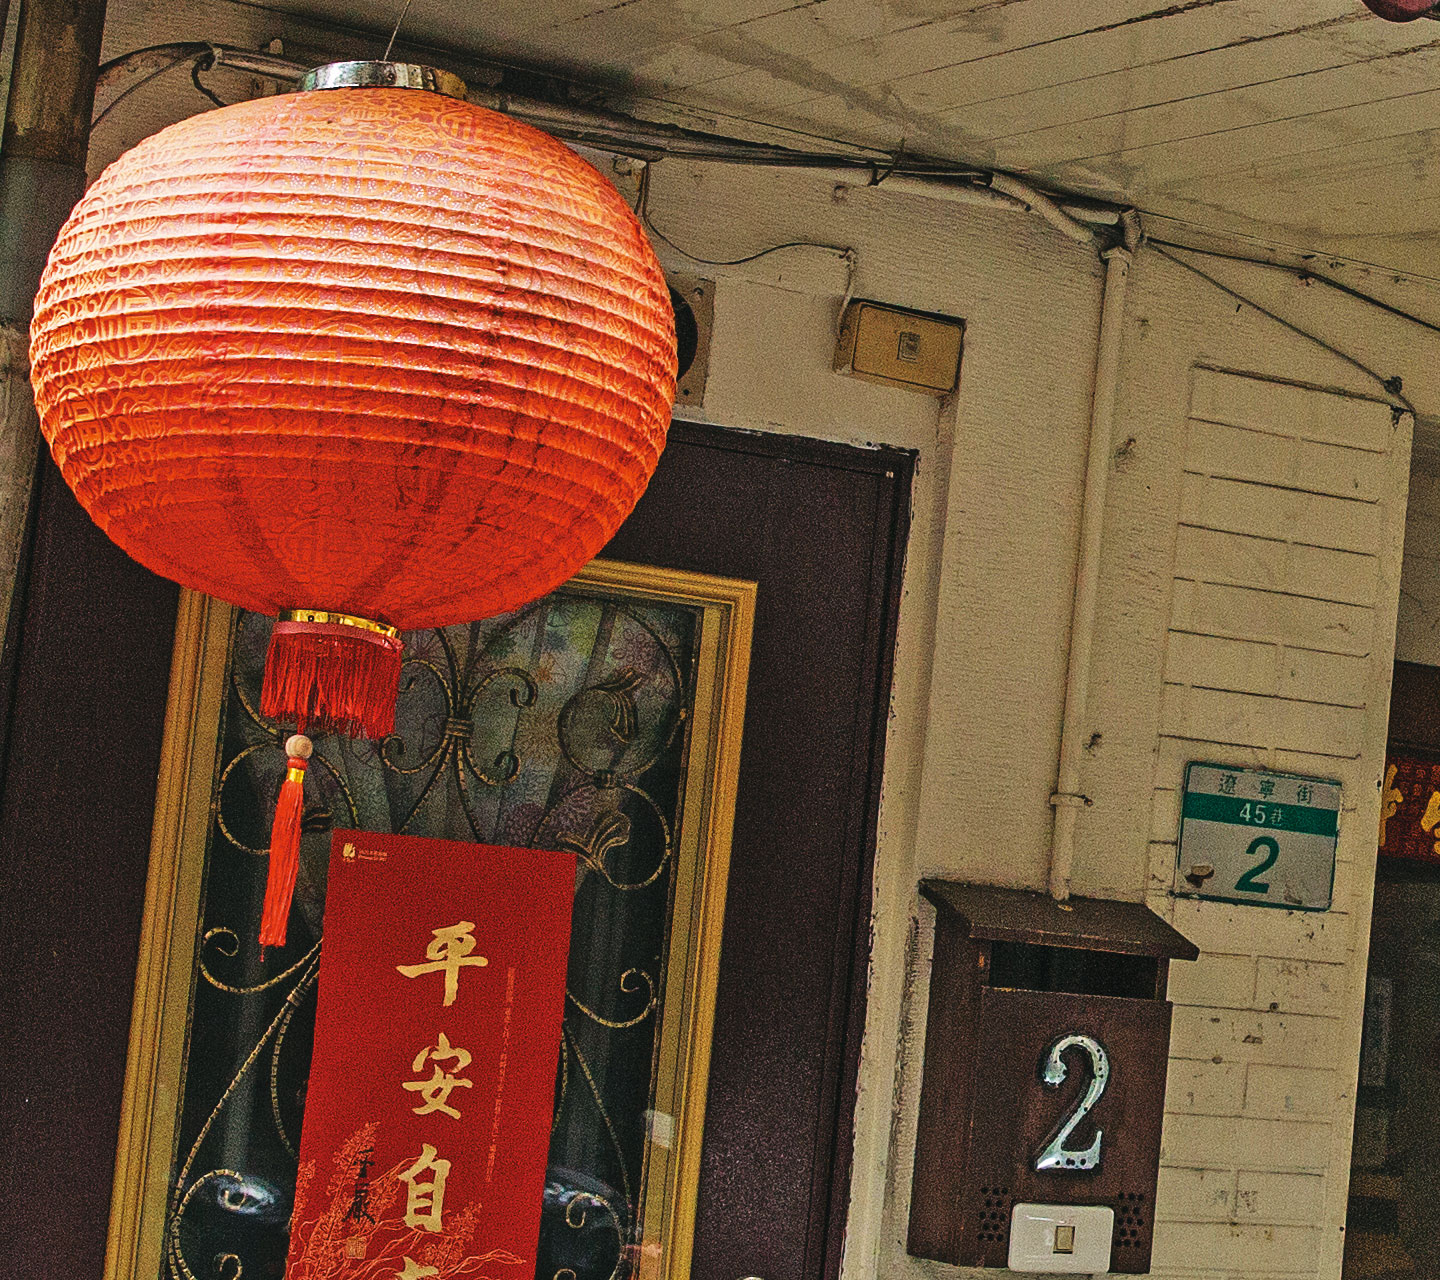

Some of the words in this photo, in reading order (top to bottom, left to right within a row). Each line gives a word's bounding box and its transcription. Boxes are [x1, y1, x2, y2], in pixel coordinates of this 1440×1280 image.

[1217, 772, 1313, 805] 遼寧街
[1234, 835, 1281, 894] 2
[1036, 1032, 1111, 1172] 2
